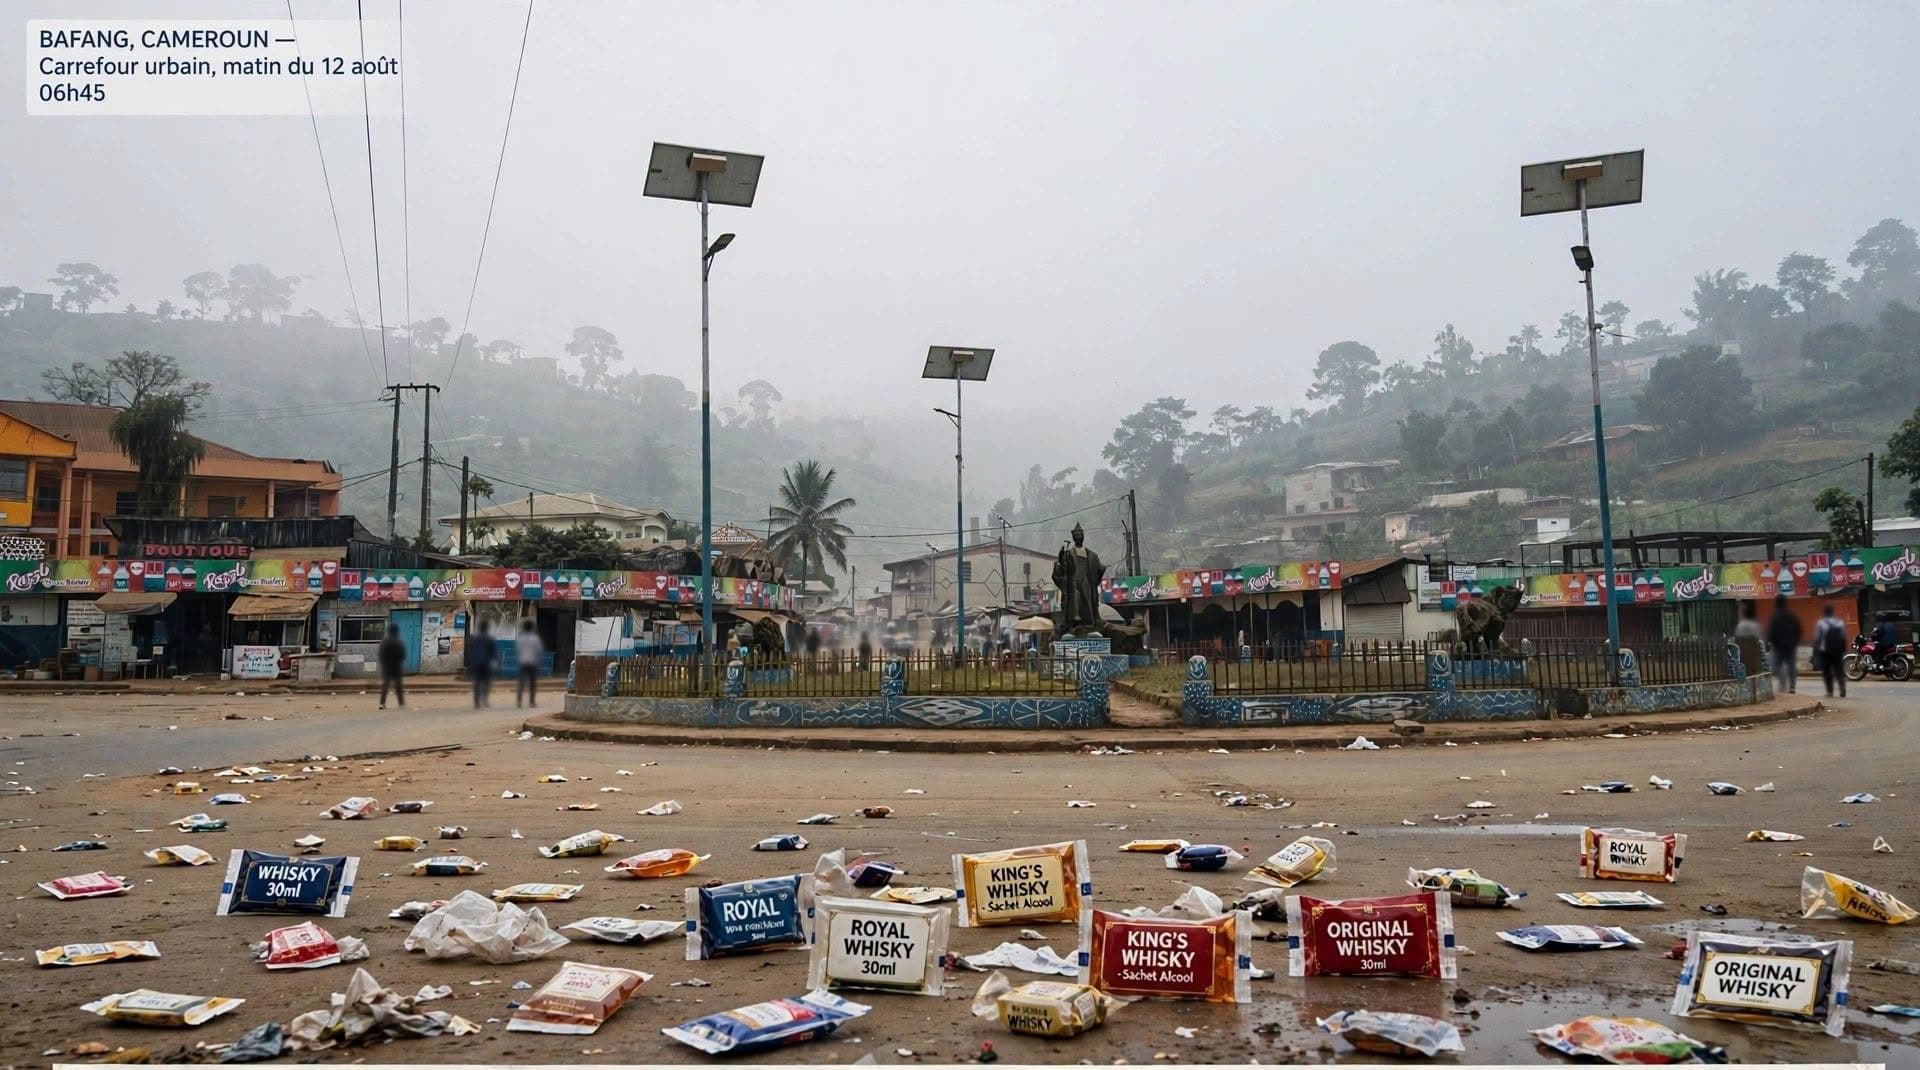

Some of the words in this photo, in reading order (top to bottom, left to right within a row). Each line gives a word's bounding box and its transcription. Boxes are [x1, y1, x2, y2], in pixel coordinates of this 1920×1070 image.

[1609, 841, 1648, 856] ROYAL
[258, 864, 321, 882] WHISKY
[990, 864, 1043, 882] KING'S
[265, 881, 302, 898] 30ml
[986, 880, 1050, 899] WHISKY
[722, 897, 781, 922] ROYAL
[850, 919, 910, 940] ROYAL
[1327, 920, 1414, 938] ORIGINAL
[1127, 930, 1189, 949] KING'S
[1335, 938, 1408, 956] WHISKY
[843, 938, 915, 960] WHISKY
[1121, 949, 1196, 968] WHISKY
[1360, 959, 1387, 970] 30ml
[861, 960, 896, 976] 30ml
[1159, 970, 1194, 983] Alcool
[1714, 960, 1806, 983] ORIGINAL
[1718, 977, 1797, 1000] WHISKY
[1007, 1014, 1053, 1032] WHISKY
